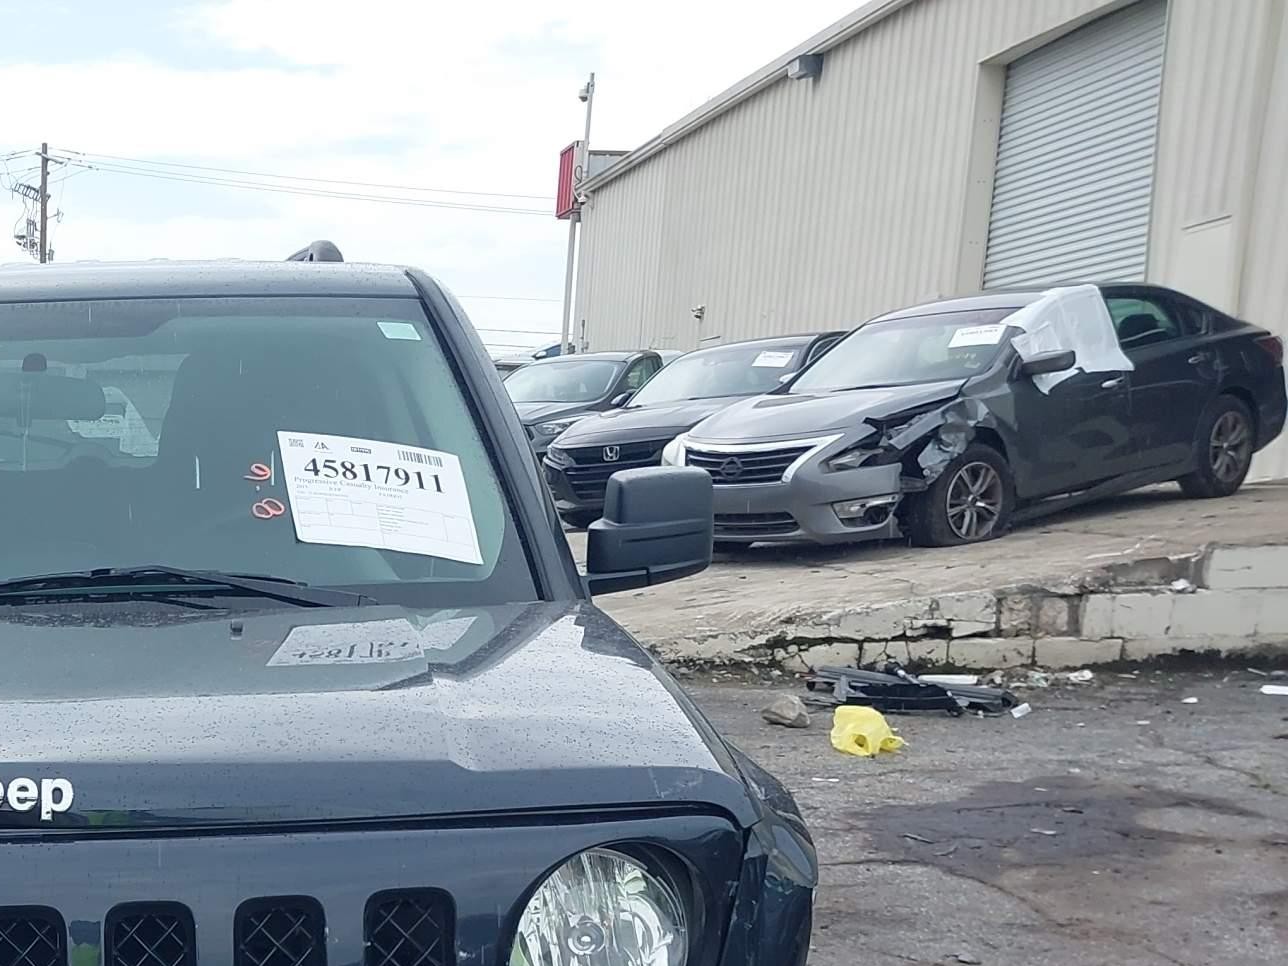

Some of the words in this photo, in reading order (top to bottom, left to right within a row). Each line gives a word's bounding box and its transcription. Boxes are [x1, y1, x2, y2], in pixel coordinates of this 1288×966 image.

[294, 476, 338, 486] Progressive
[339, 479, 372, 490] Casualty
[375, 484, 409, 494] Insurance
[304, 457, 445, 494] 45817911
